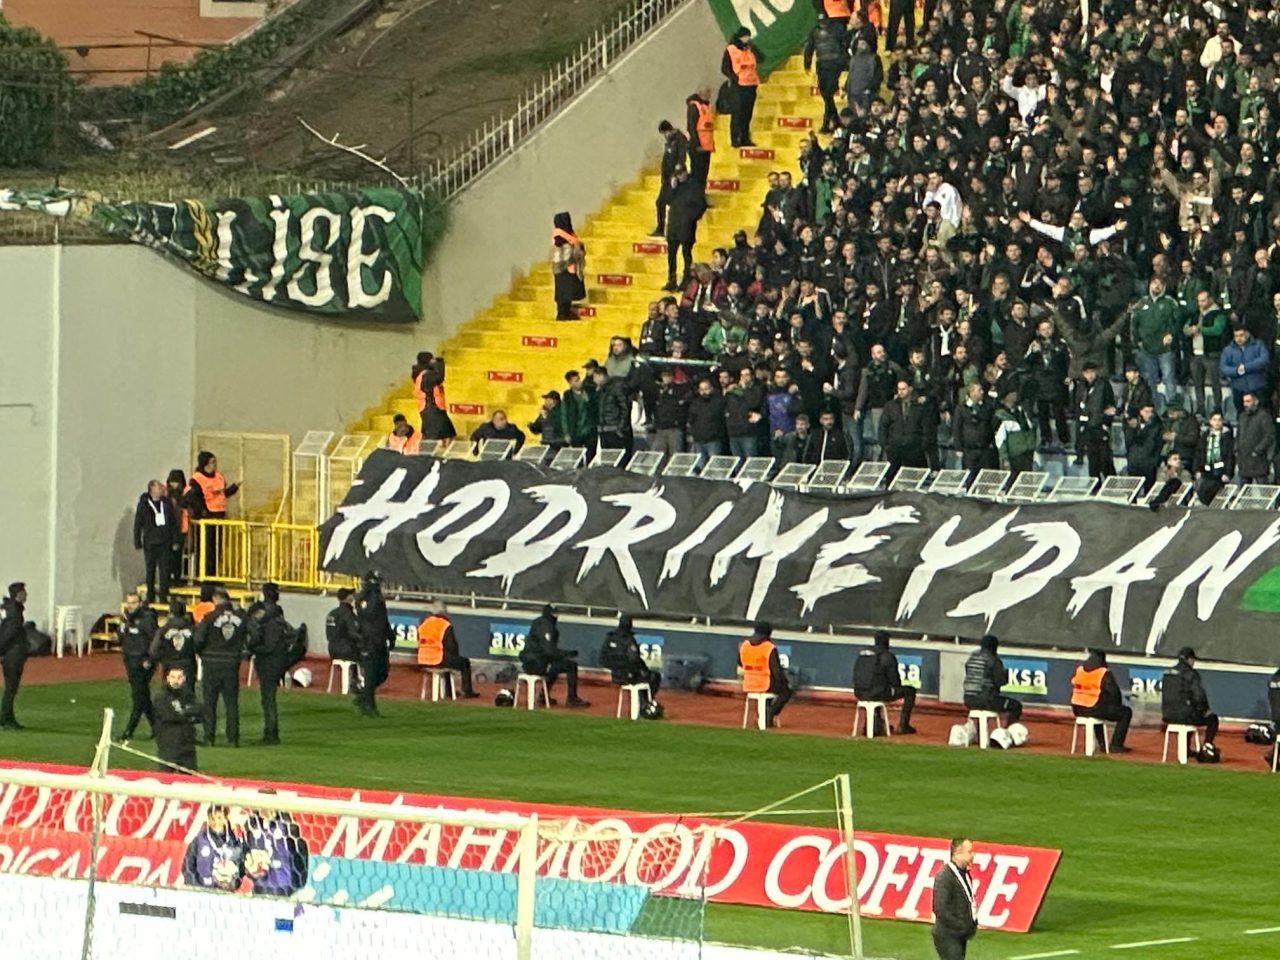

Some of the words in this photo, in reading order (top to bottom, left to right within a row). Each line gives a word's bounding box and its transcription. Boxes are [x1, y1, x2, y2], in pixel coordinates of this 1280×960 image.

[491, 631, 526, 651] aks
[1008, 667, 1047, 688] ksa
[321, 791, 748, 898] MAHMOOD
